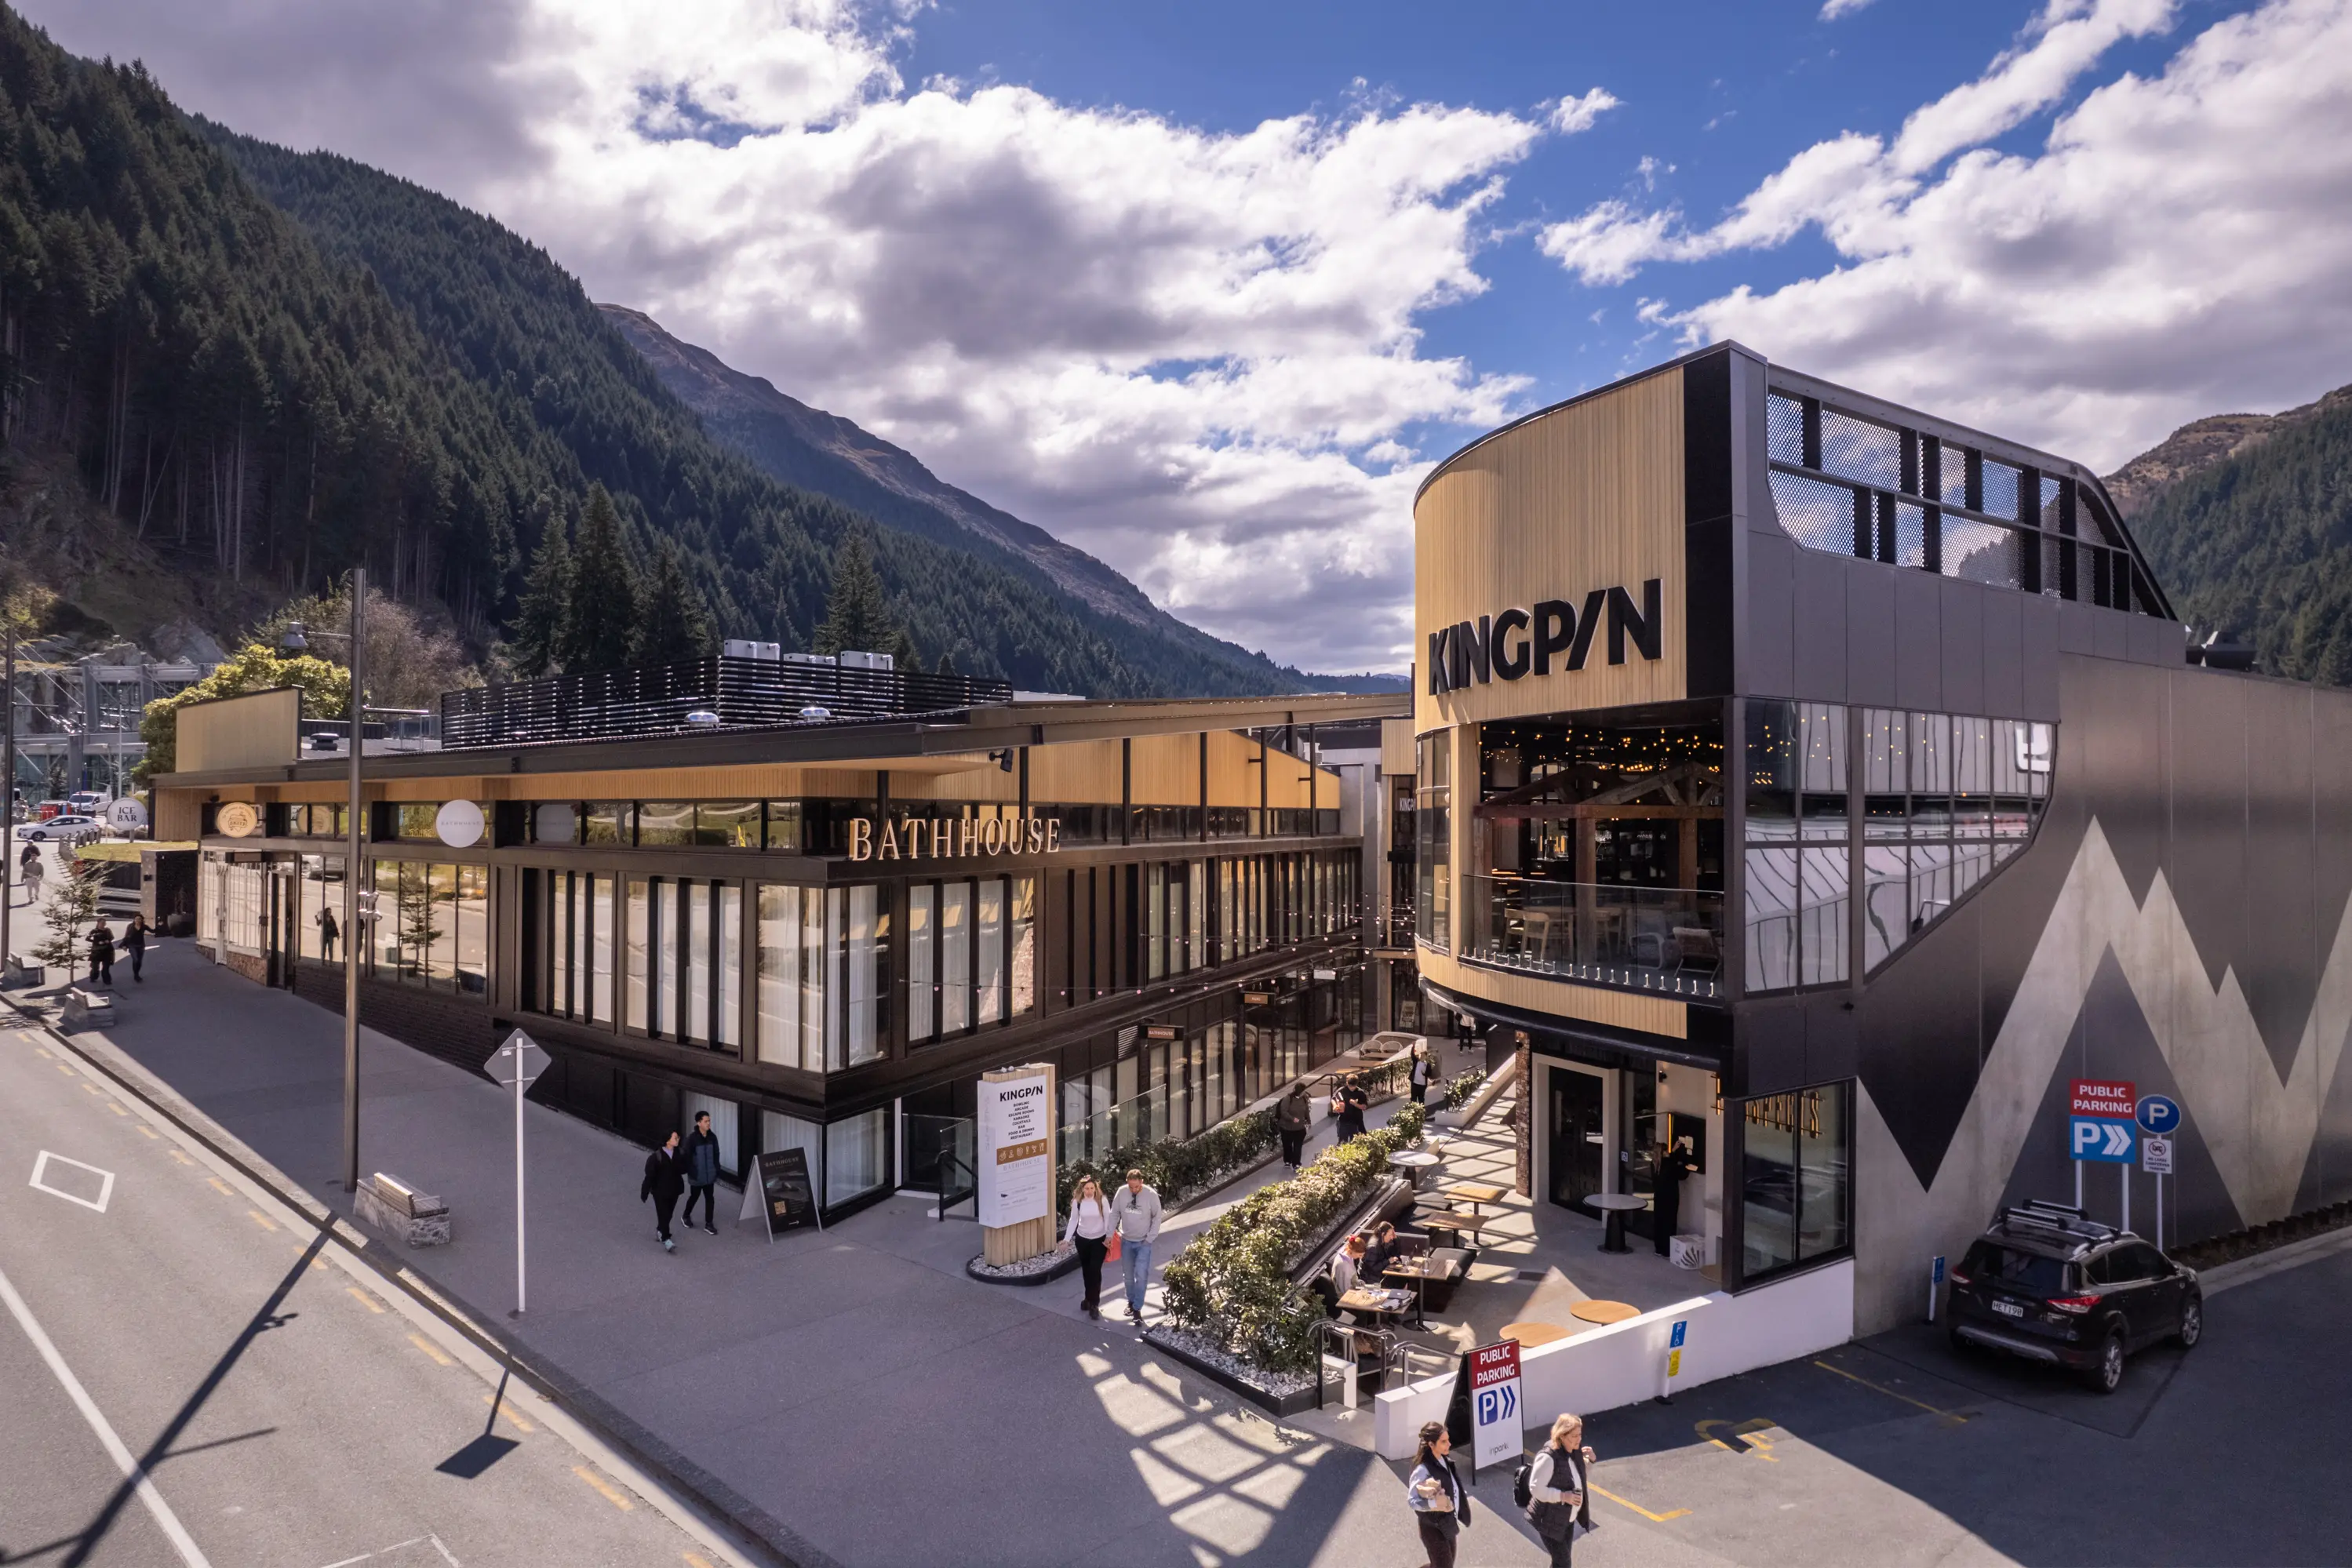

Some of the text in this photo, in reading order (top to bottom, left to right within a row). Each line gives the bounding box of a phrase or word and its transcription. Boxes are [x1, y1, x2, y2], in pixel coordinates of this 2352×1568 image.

[850, 817, 1060, 861] BATHHOUSE
[2079, 1085, 2126, 1098] PUBLIC
[2073, 1099, 2132, 1113] PARKING
[2150, 1103, 2169, 1124] P
[2074, 1122, 2101, 1154] P
[1480, 1345, 1510, 1365] PUBLIC
[1476, 1363, 1515, 1385] PARKING
[1482, 1393, 1495, 1424] P
